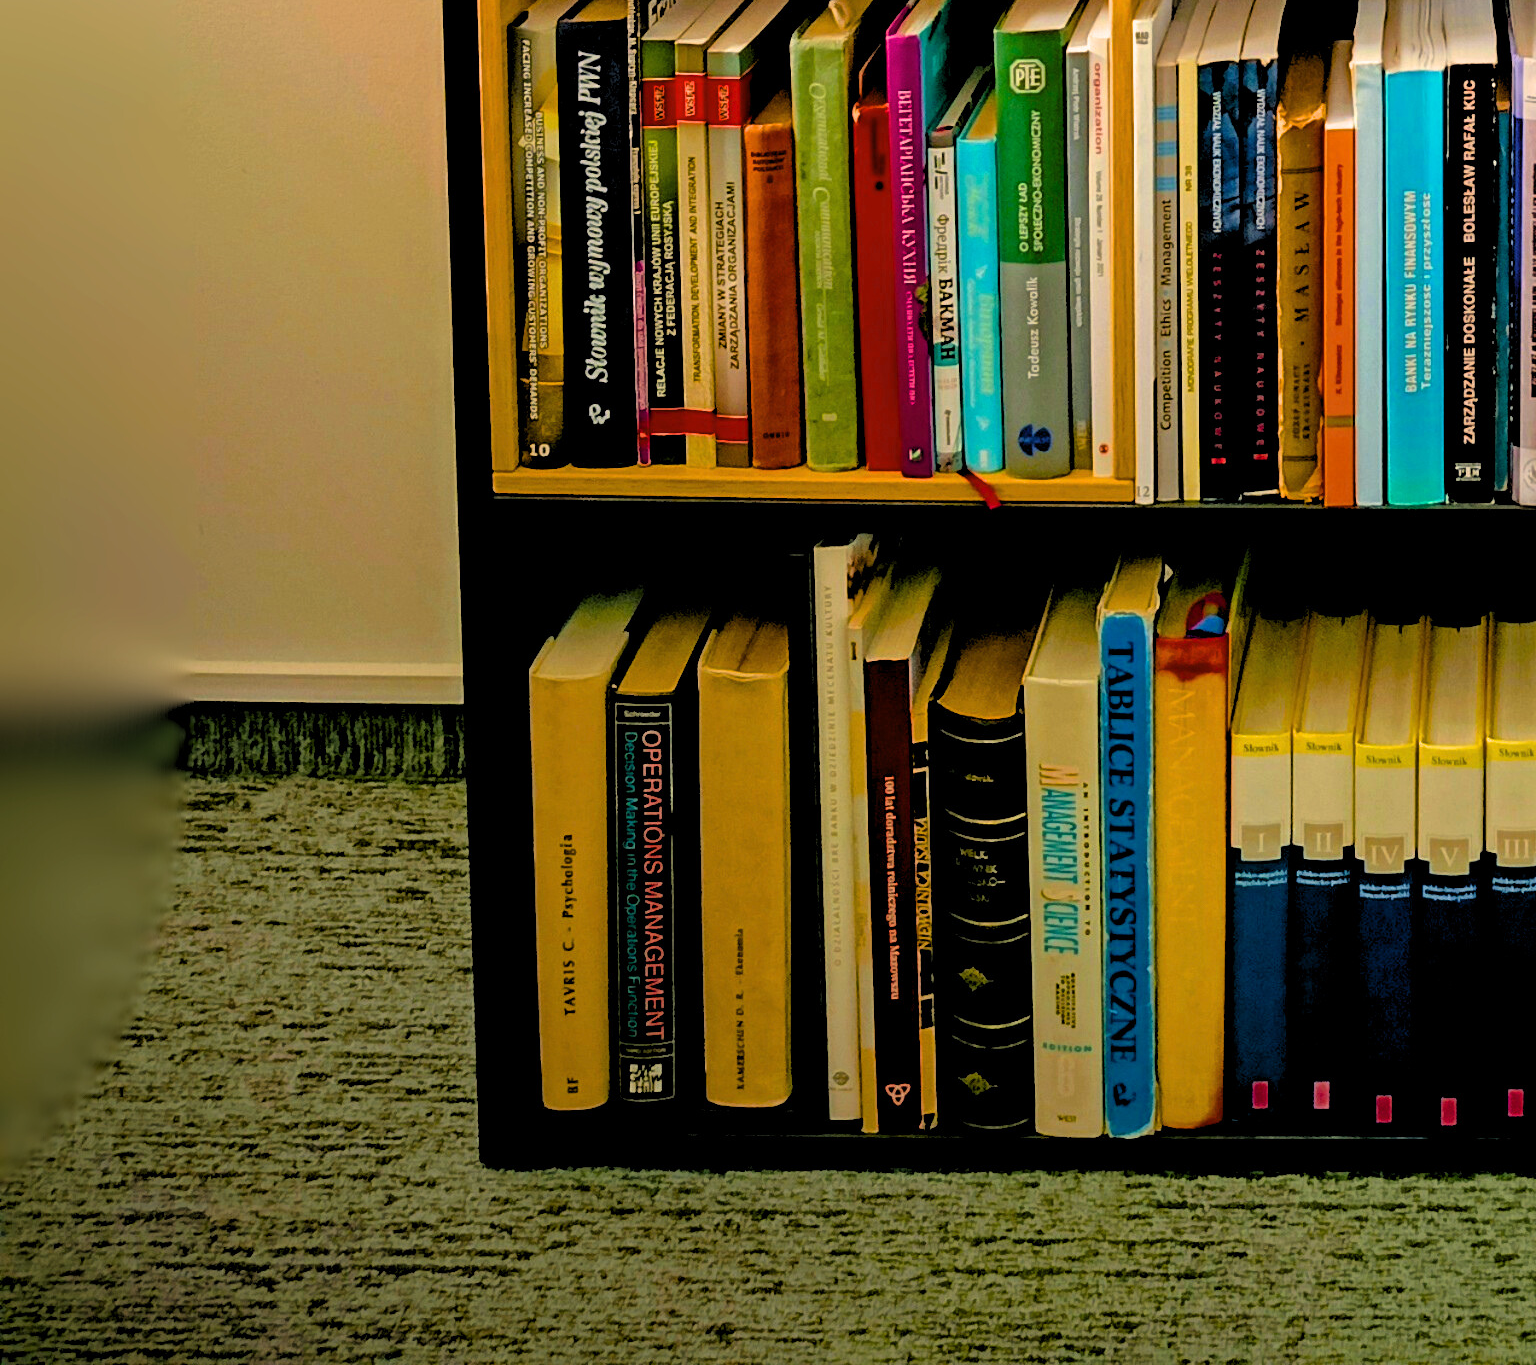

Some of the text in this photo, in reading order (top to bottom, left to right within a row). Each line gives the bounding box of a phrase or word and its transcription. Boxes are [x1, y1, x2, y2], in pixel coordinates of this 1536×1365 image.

[1014, 63, 1041, 87] PTE
[1031, 110, 1043, 252] SPOŁECZNO-EKONOMICZNY
[578, 51, 611, 382] Słownik wymowy polskiej PWN
[1018, 183, 1029, 252] O LEPSZY ŁAD
[1463, 79, 1478, 444] ZARZĄDZANIE DOSKONAŁE BOLESŁAW RAFAŁ KUC
[1160, 198, 1174, 431] Competition Ethics Management
[1026, 277, 1040, 379] Tadeusz Kowalik
[1244, 743, 1280, 753] Słownik
[1306, 741, 1343, 753] Słownik
[1366, 755, 1402, 765] Słownik
[1431, 757, 1468, 767] Słownik
[1108, 643, 1137, 1063] TABLICE STATYSTYCZNE
[1315, 831, 1332, 851] II
[1505, 838, 1530, 857] III
[1370, 845, 1398, 867] IV
[1440, 847, 1458, 867] V
[643, 729, 665, 1040] OPERATIONS MANAGEMENT
